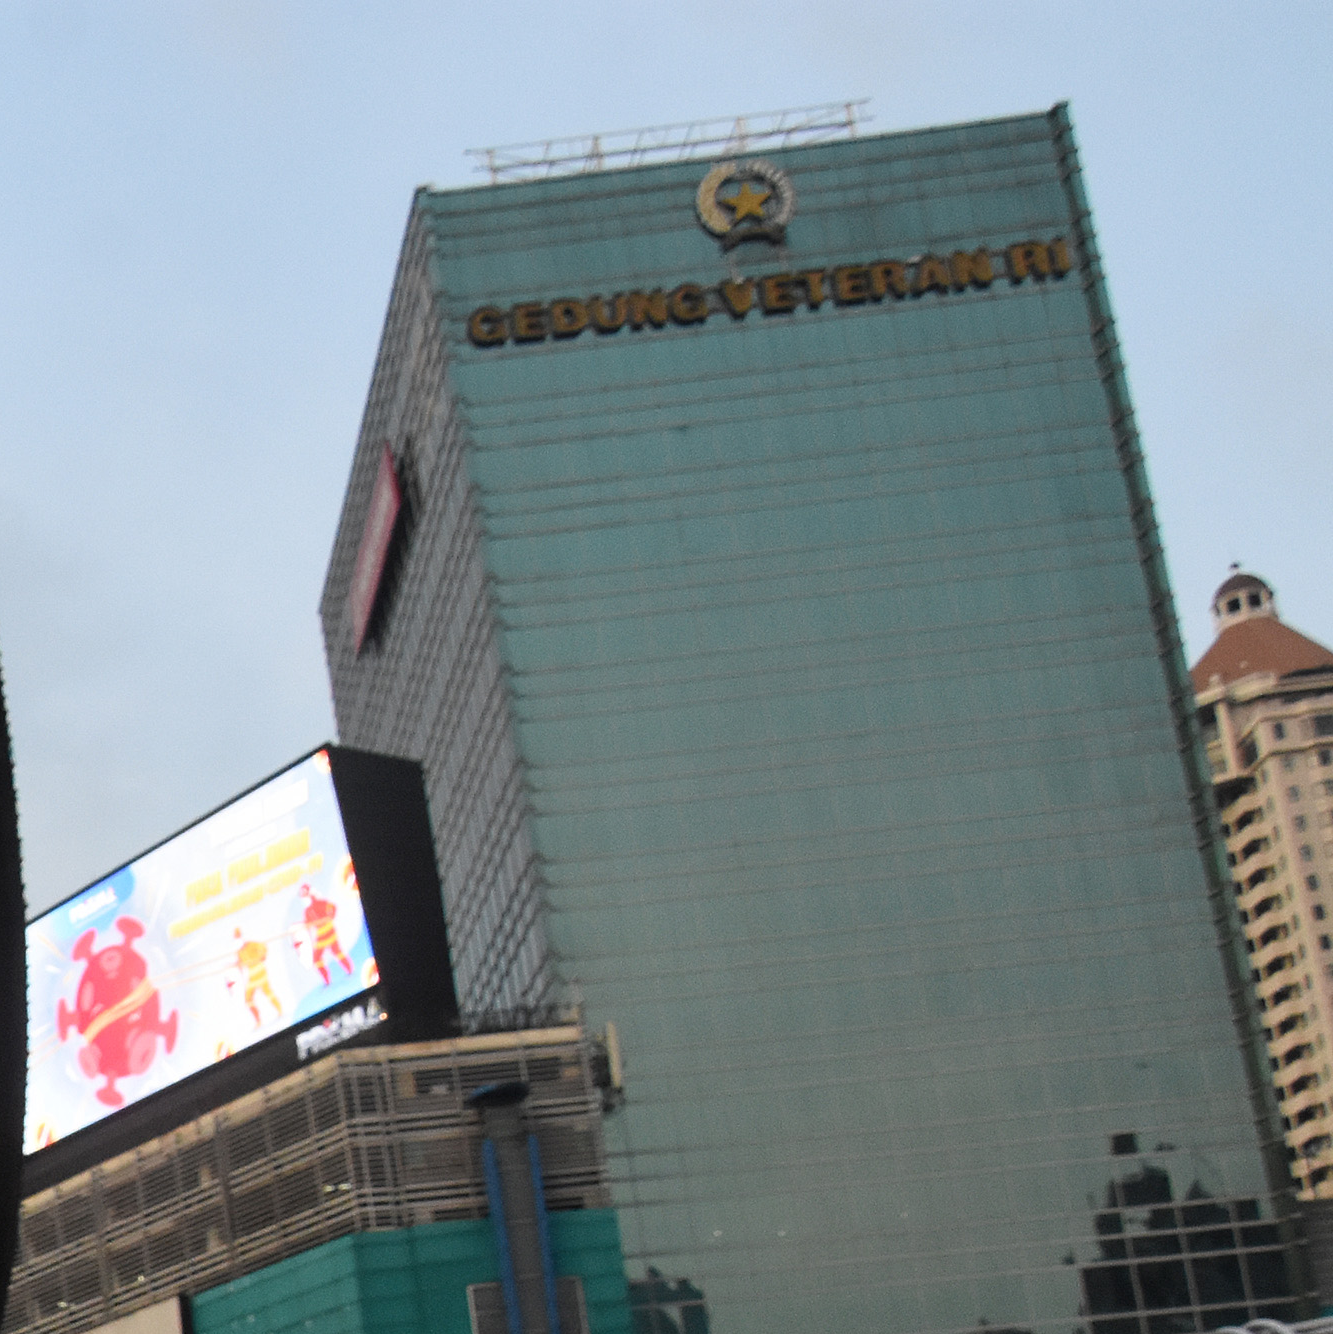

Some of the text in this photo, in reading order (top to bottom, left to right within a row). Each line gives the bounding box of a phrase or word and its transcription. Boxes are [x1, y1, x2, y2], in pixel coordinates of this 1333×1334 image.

[468, 236, 1074, 348] GEDUNG VETERAN RI
